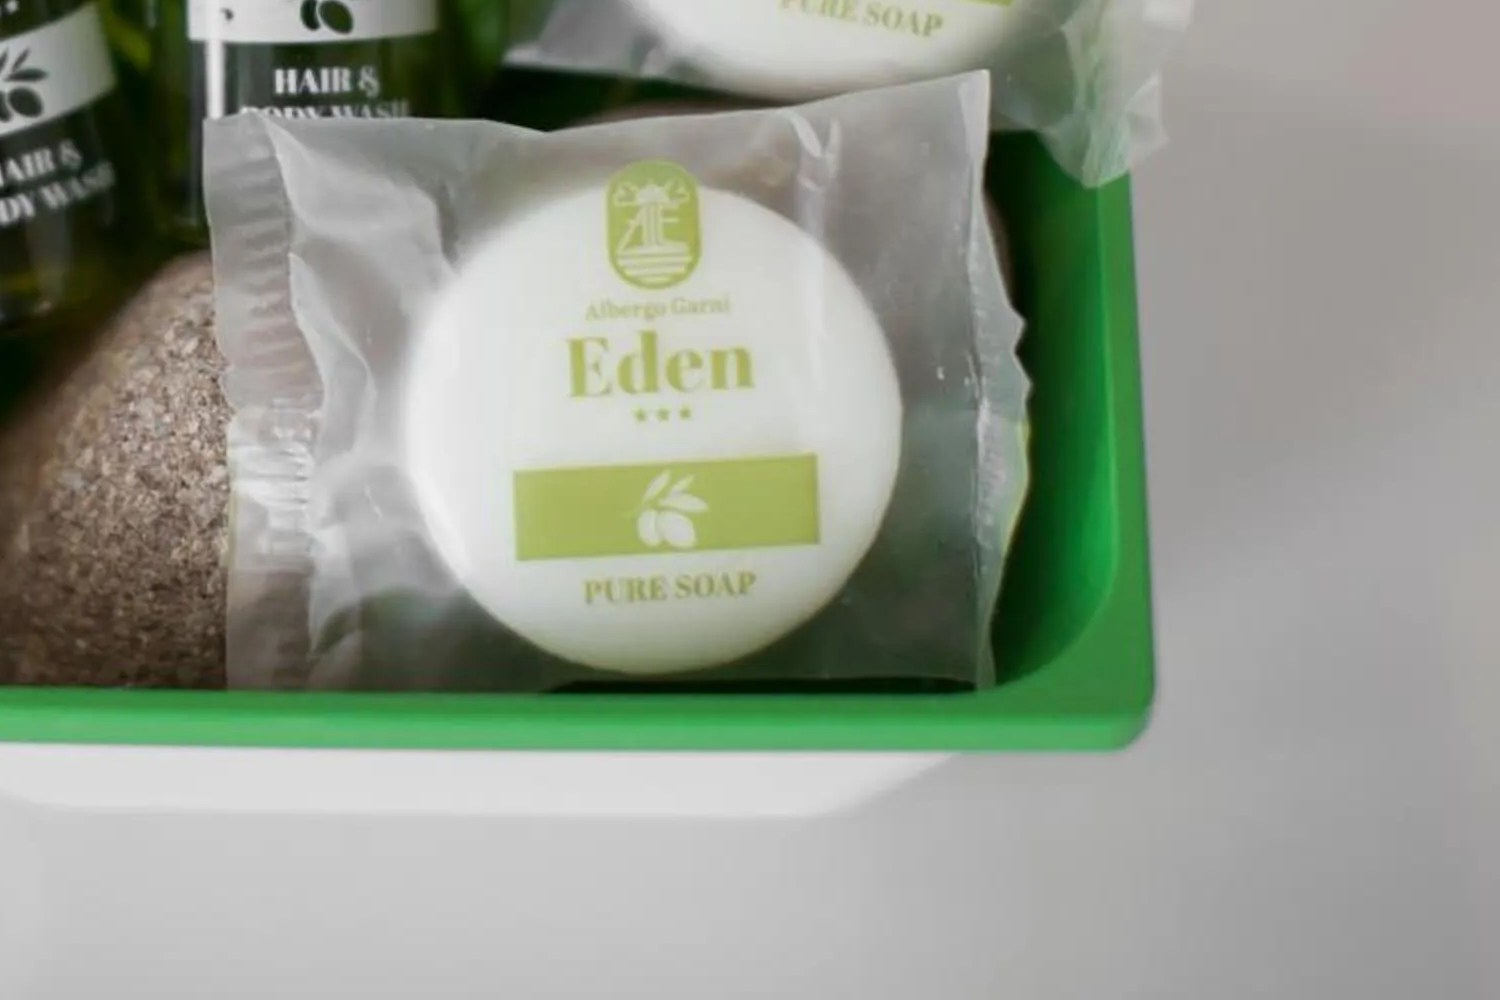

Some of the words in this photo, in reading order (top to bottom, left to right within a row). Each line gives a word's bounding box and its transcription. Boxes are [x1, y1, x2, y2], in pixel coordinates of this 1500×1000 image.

[862, 1, 944, 38] SOAP
[274, 67, 351, 95] HAIR
[358, 65, 380, 98] &
[58, 138, 83, 170] &
[585, 298, 667, 322] Albergo
[565, 329, 755, 398] Eden
[582, 575, 667, 605] PURE
[673, 570, 756, 599] SOAP
